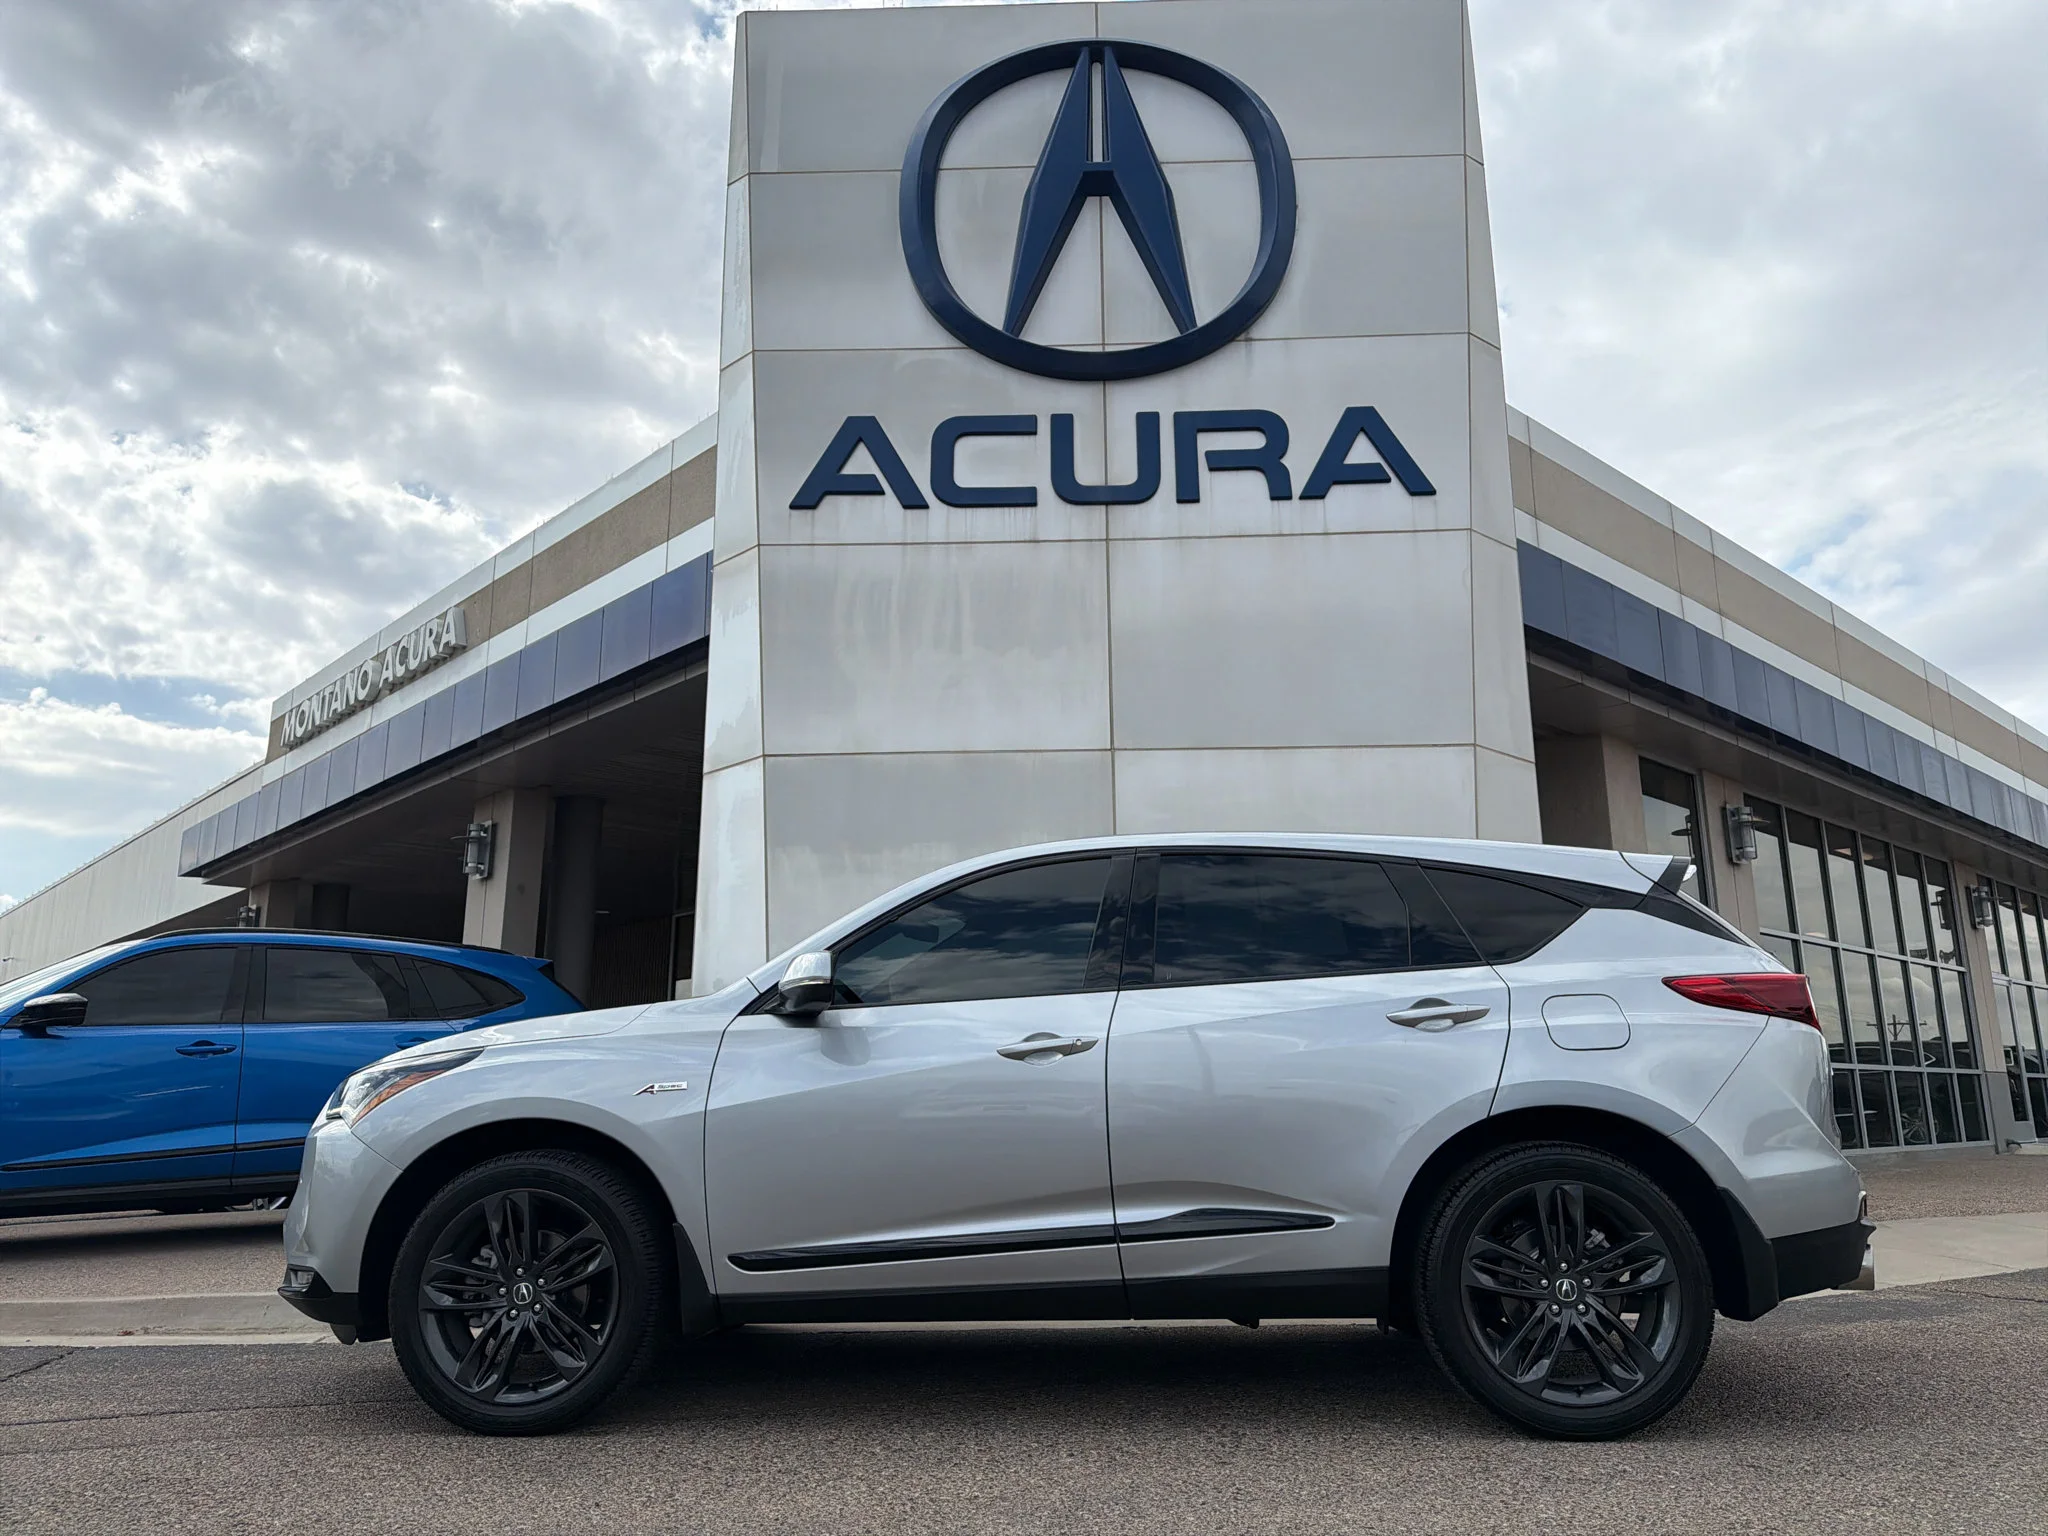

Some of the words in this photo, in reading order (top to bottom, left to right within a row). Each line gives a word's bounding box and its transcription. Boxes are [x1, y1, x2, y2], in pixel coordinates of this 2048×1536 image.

[790, 406, 1437, 509] ACURA
[280, 660, 378, 746] MONTANO
[379, 608, 464, 689] ACURA
